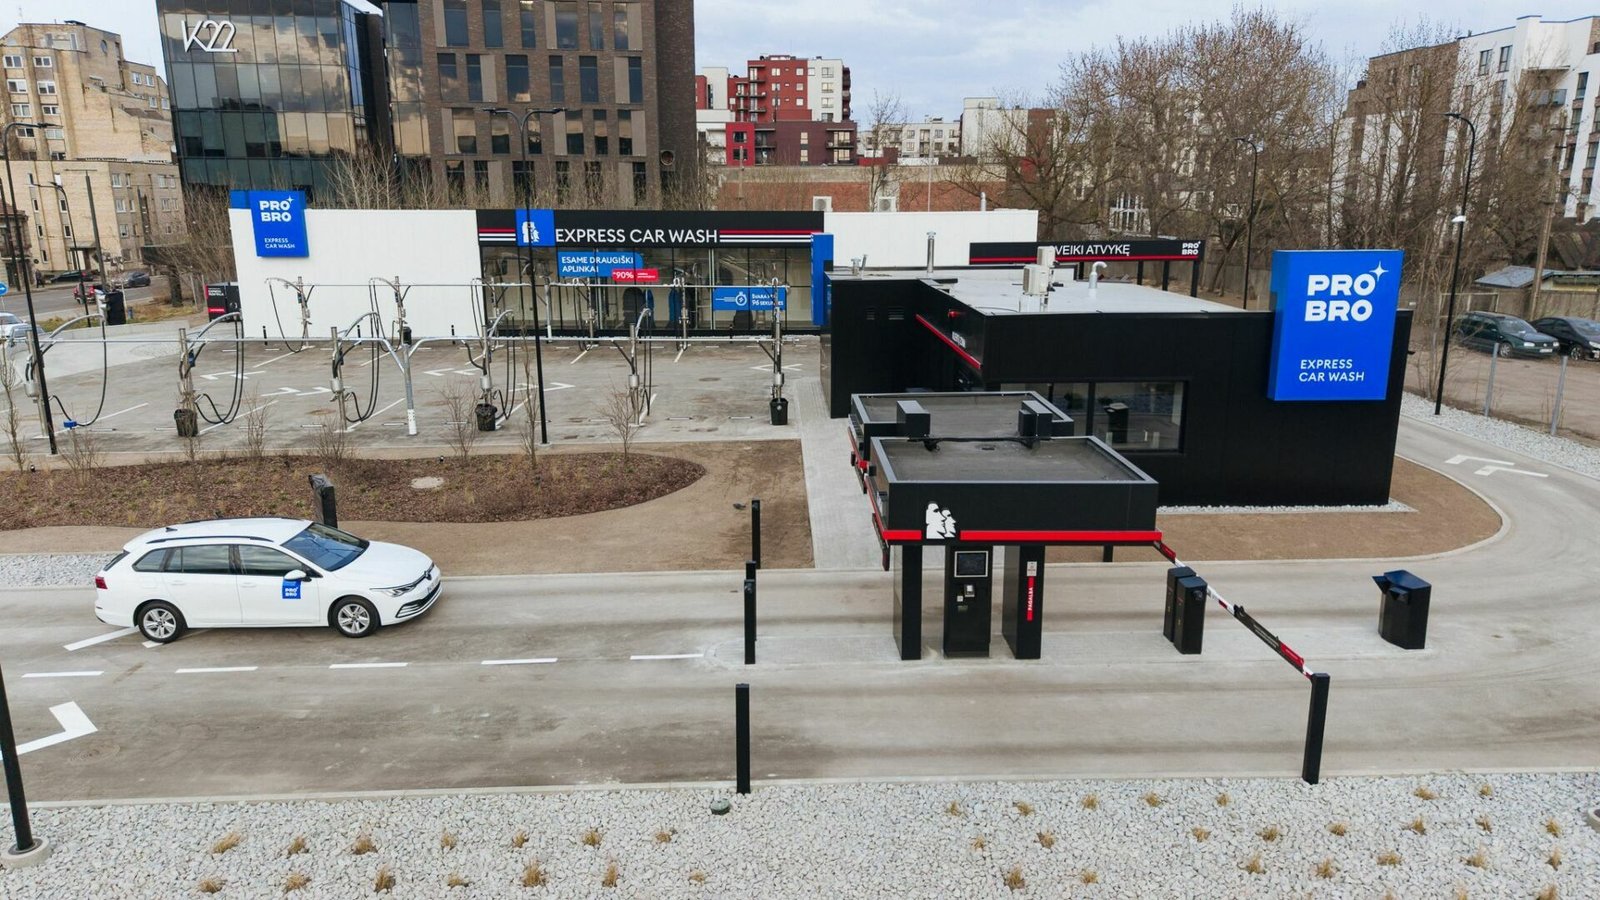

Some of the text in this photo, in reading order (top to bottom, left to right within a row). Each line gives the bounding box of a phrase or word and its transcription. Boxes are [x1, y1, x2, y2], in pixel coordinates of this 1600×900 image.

[181, 20, 238, 52] K22
[259, 200, 290, 211] PRO
[261, 212, 292, 222] BRO
[555, 228, 718, 243] EXPRESS CAR WASH
[1052, 244, 1131, 257] VEIKI ATVYKĘ
[1181, 248, 1199, 256] BRO
[561, 255, 634, 264] ESAME DRAUGIŠKI
[562, 265, 599, 273] APLINKAI
[1307, 273, 1376, 296] PRO
[1304, 299, 1373, 322] BRO
[1300, 359, 1353, 370] EXPRESS
[1298, 372, 1365, 382] CAR WASH
